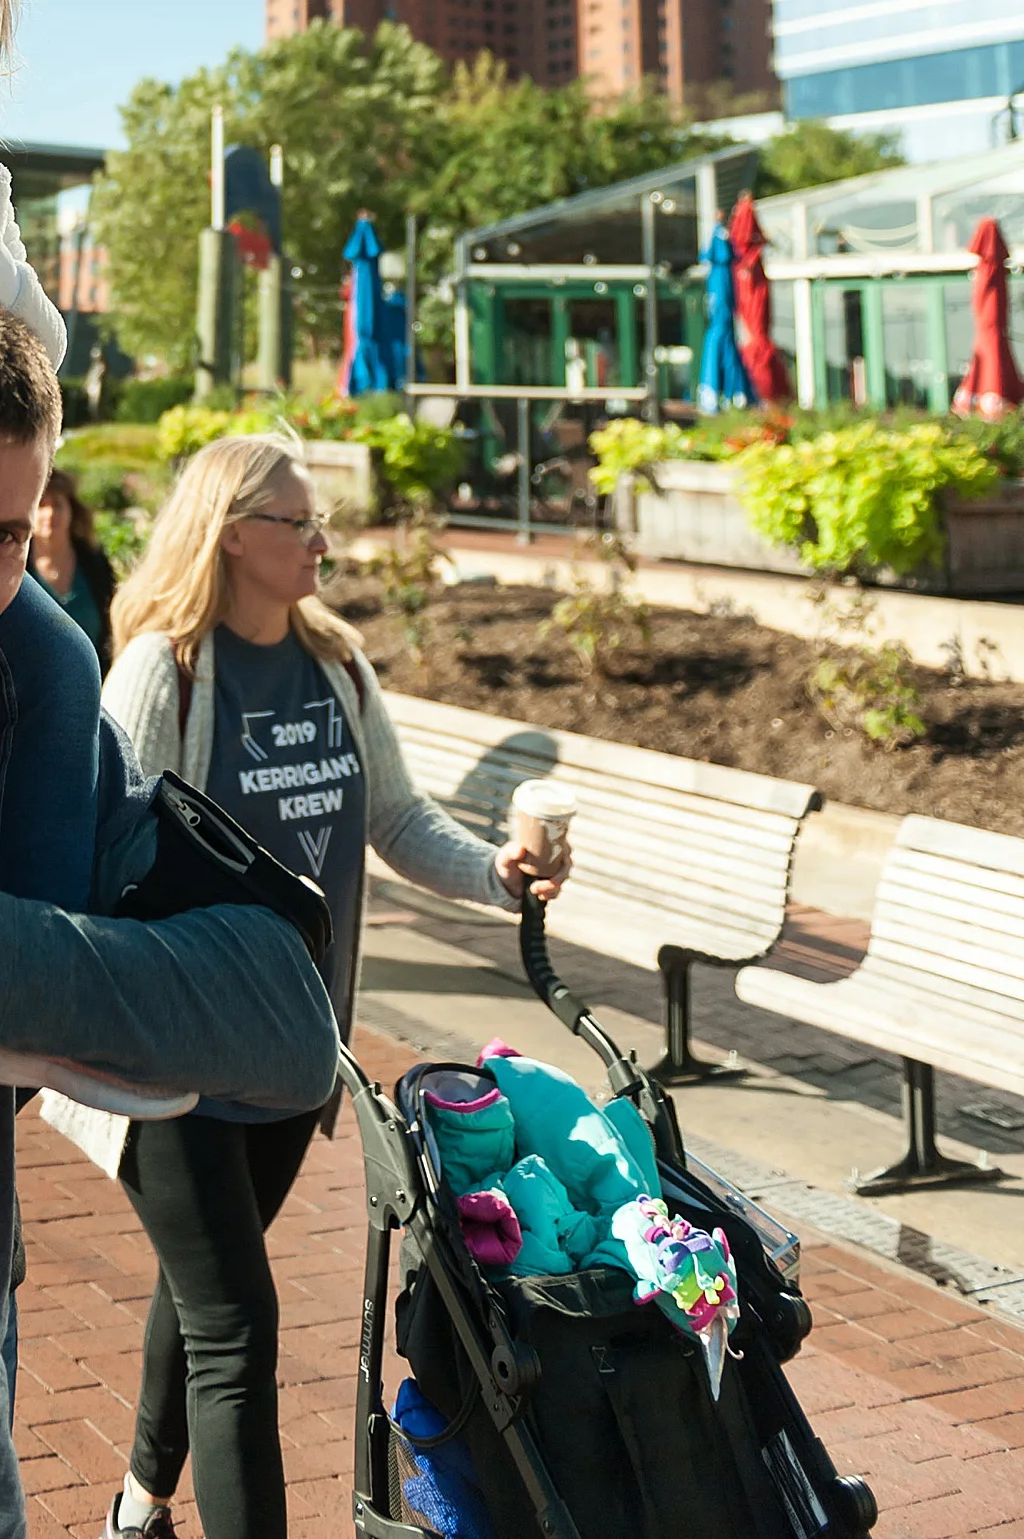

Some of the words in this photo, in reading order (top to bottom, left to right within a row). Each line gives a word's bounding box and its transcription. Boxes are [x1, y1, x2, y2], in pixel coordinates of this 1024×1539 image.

[271, 720, 318, 747] 2019
[238, 752, 361, 795] KERRIGAN'S
[278, 787, 344, 822] KREW
[360, 1298, 374, 1379] summer
